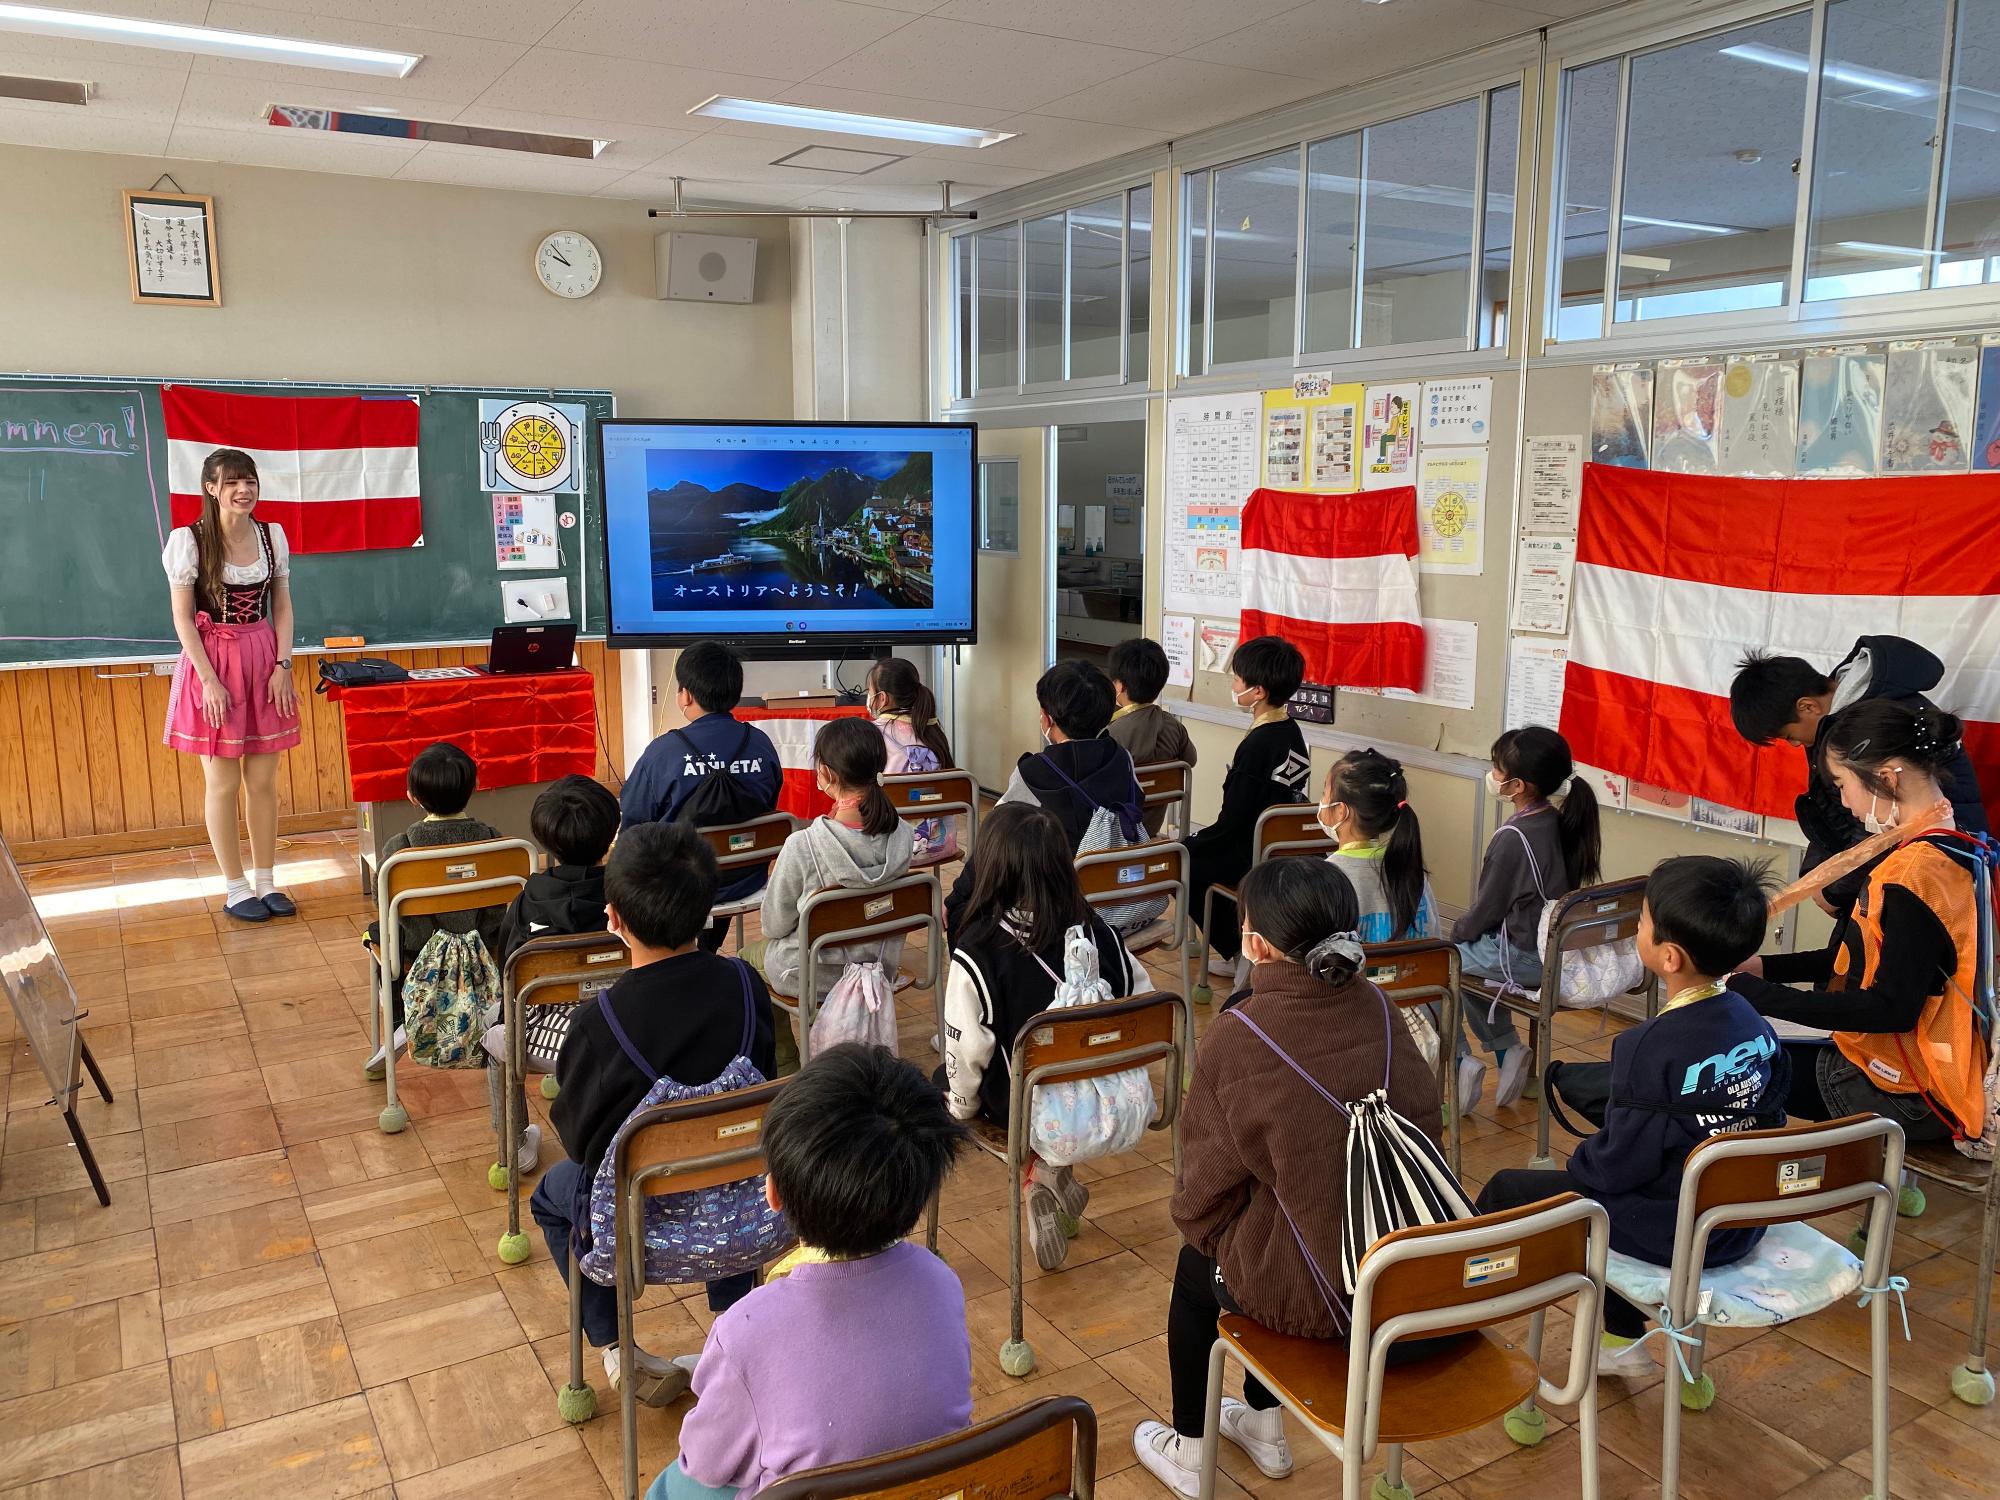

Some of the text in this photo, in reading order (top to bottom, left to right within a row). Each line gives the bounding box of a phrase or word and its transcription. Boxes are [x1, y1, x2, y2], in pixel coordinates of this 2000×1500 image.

[673, 583, 859, 598] オーストリアへようこそ！
[1727, 1083, 1740, 1095] OLD
[1785, 1165, 1795, 1177] 3
